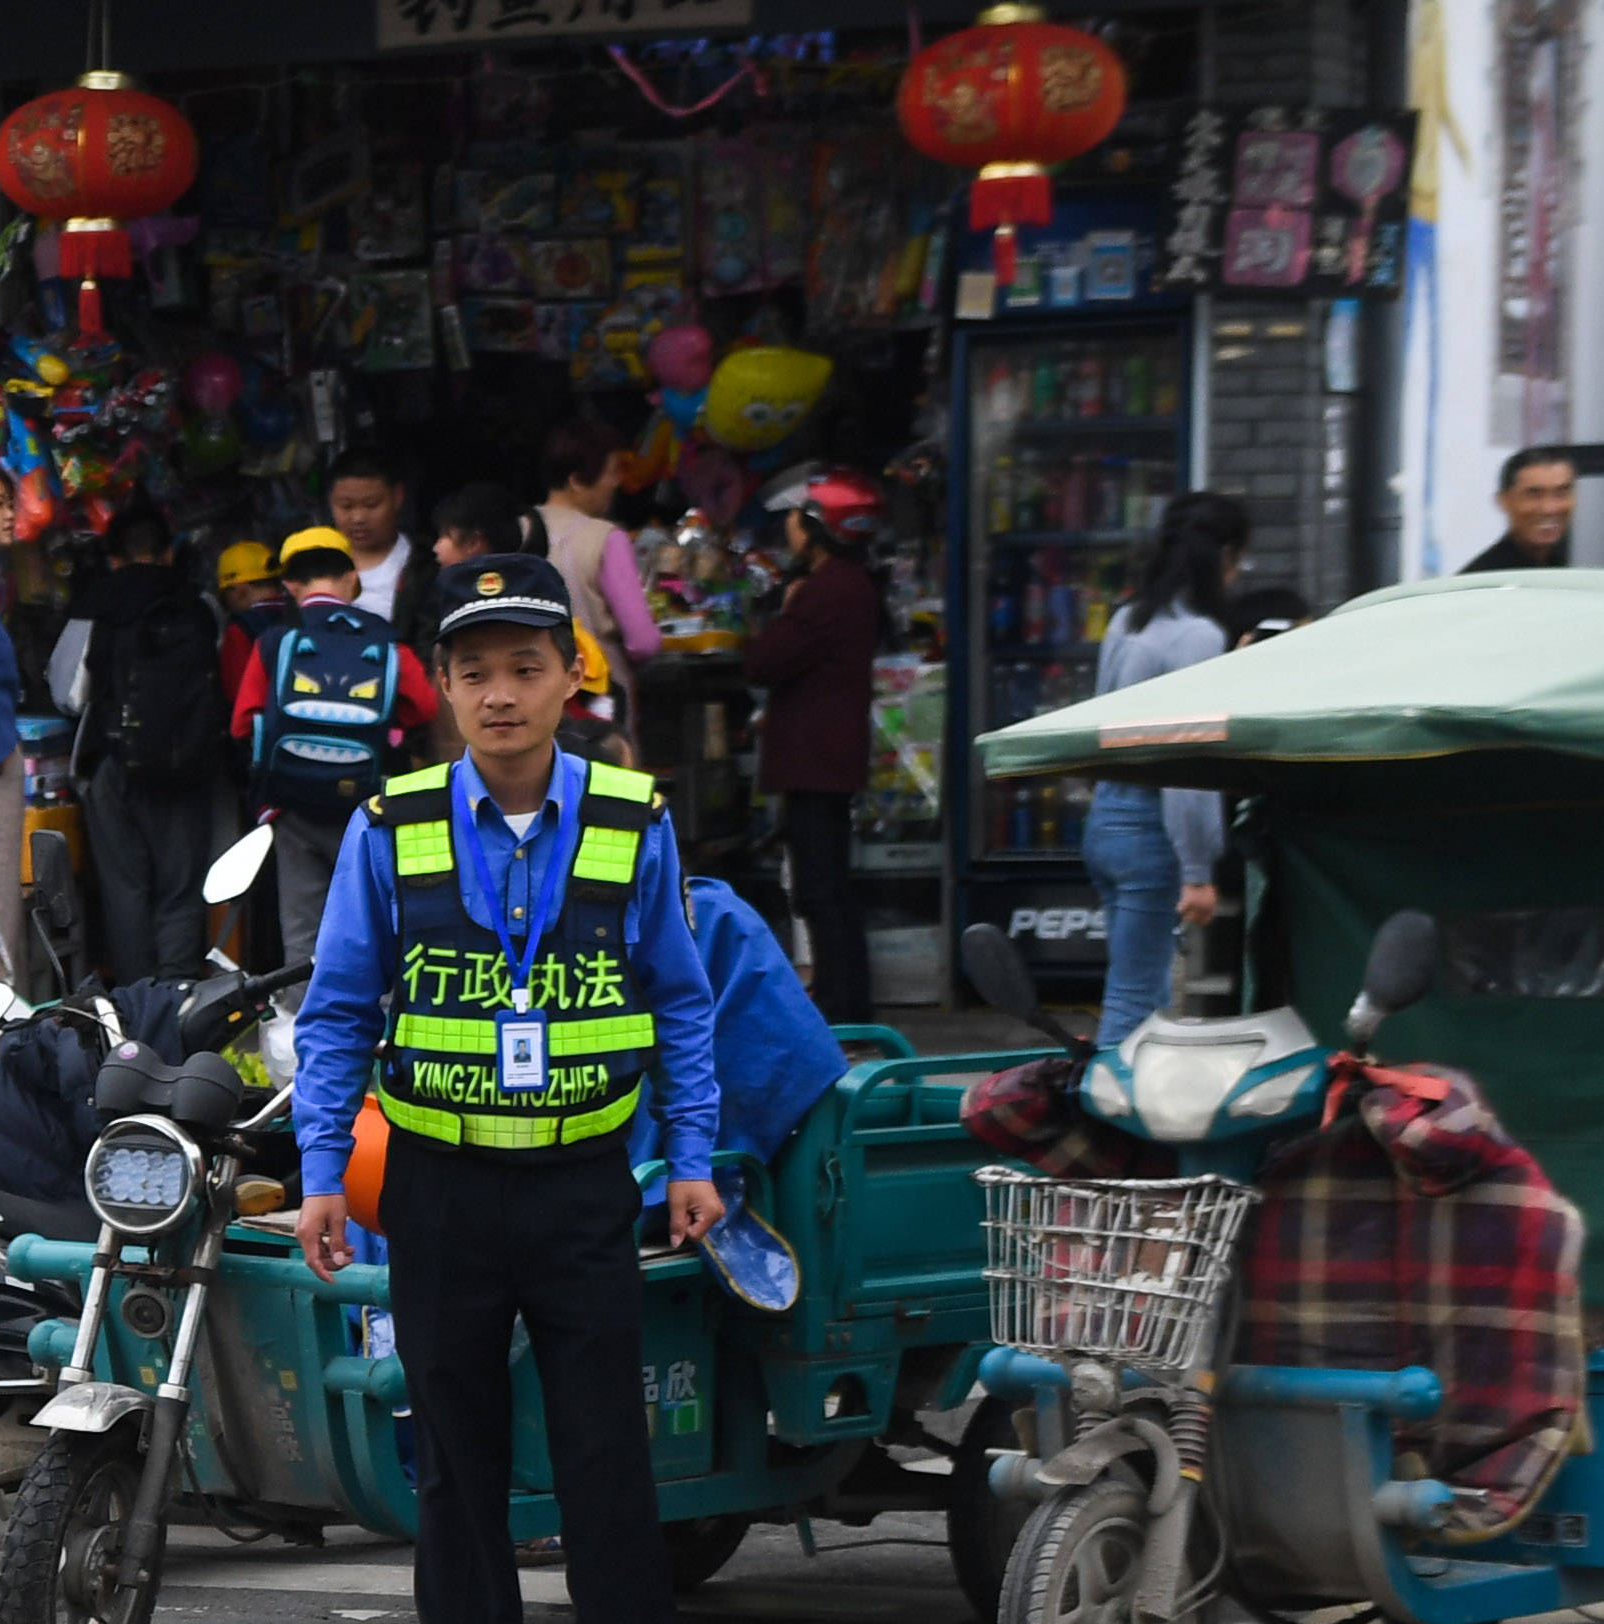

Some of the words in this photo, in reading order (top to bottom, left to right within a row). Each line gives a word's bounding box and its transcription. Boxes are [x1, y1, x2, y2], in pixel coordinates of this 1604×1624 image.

[402, 942, 627, 1010] 行政执法
[412, 1061, 610, 1108] XINGZHZHIFA
